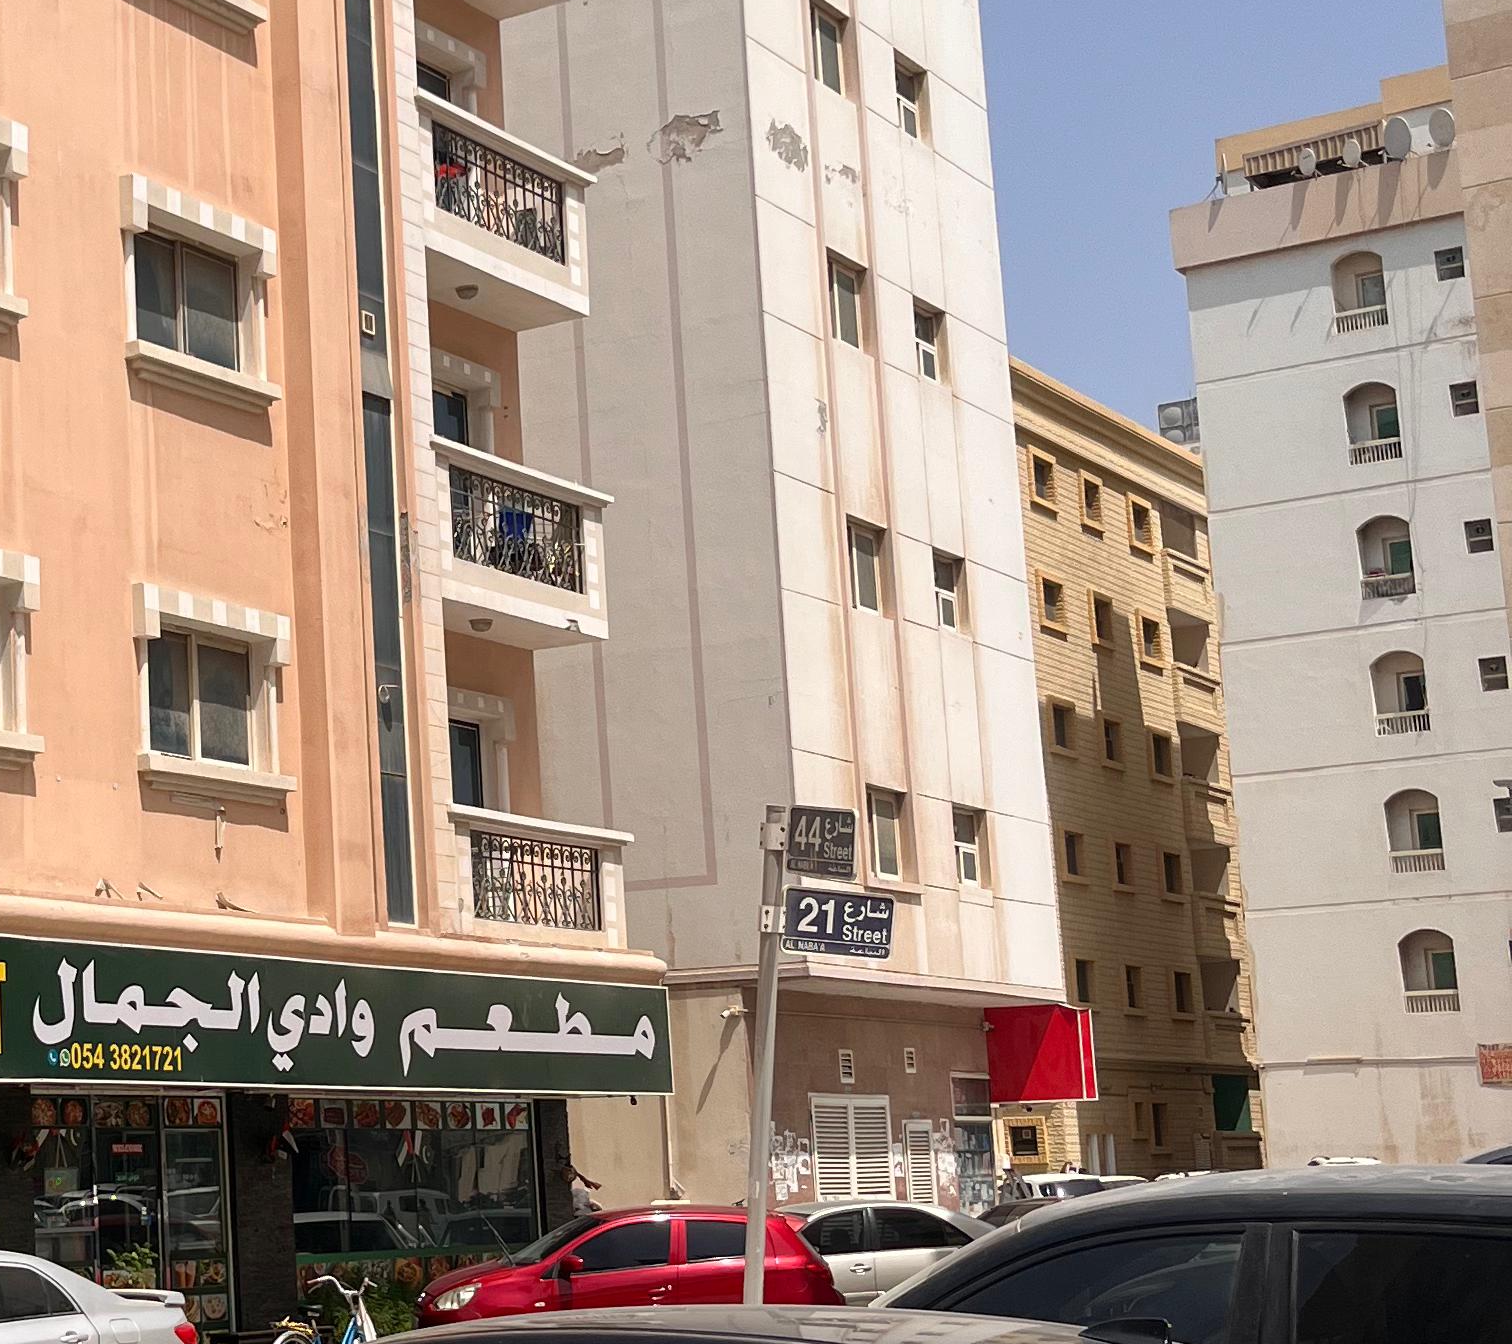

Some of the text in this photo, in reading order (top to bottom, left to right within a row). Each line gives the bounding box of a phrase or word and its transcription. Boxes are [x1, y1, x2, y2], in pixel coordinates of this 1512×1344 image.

[794, 815, 822, 852] 44
[824, 812, 853, 840] شارع
[823, 842, 853, 861] Street
[797, 896, 836, 934] 21
[843, 900, 890, 923] شارع
[785, 939, 795, 949] AL
[842, 924, 888, 944] Street
[32, 957, 656, 1077] مطعم وادي الجمال
[71, 1042, 184, 1072] 054 3821721
